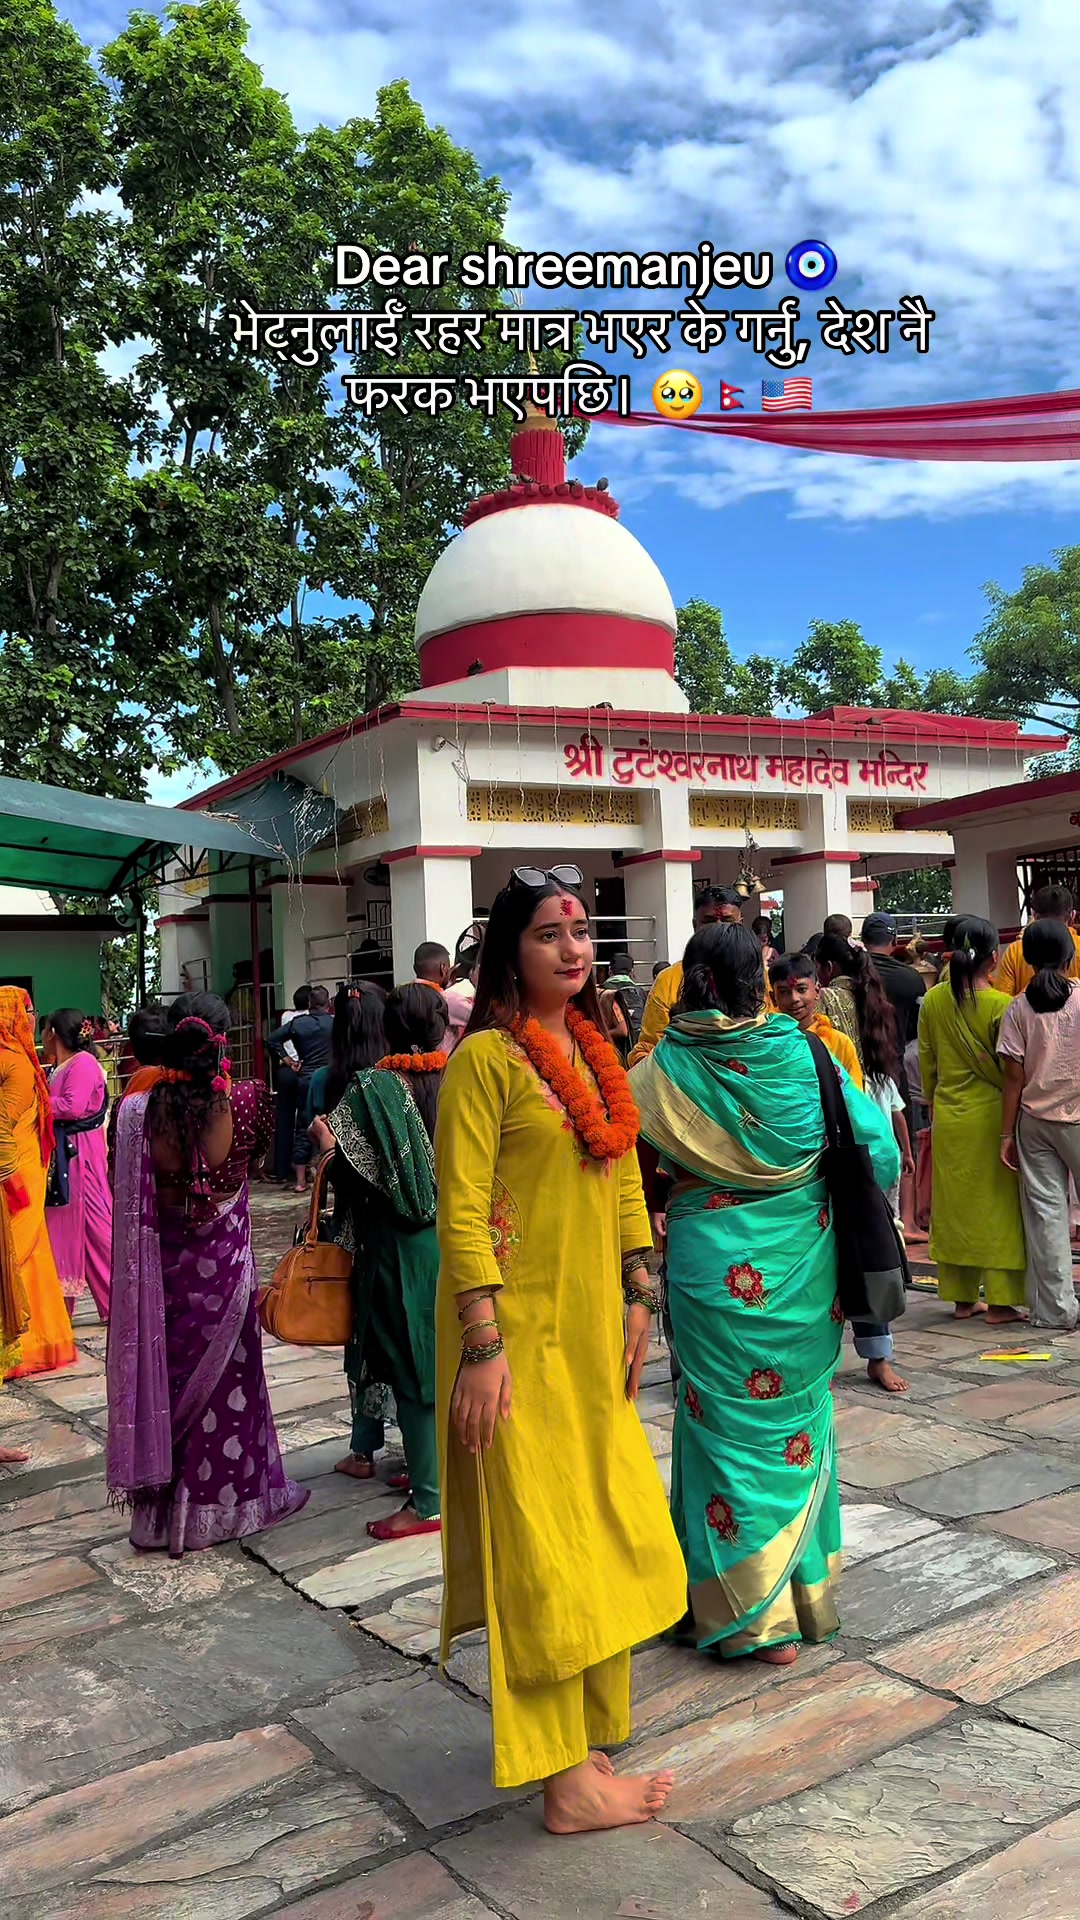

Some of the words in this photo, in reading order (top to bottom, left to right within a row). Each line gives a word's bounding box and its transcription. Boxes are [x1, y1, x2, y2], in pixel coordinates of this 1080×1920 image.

[564, 732, 604, 777] श्री
[765, 748, 850, 790] महादेव
[857, 749, 929, 792] मन्दिर
